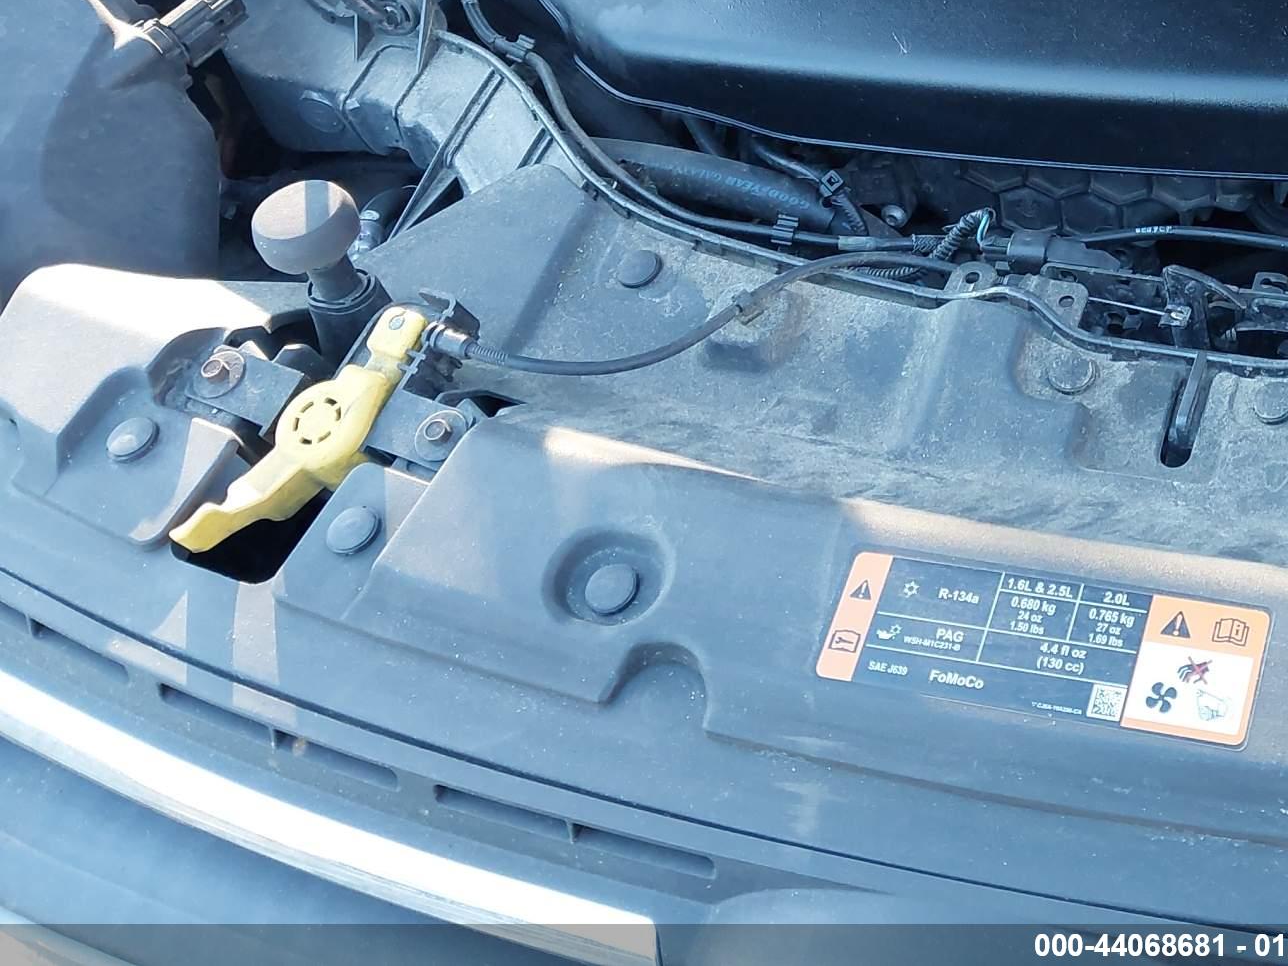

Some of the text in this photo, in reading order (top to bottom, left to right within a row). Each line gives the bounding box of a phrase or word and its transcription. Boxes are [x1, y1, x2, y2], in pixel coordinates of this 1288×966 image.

[938, 587, 980, 605] R-134a
[1007, 578, 1073, 598] 1.6L & 2.5L
[1010, 597, 1056, 616] 0.680 kg
[1103, 591, 1130, 606] 2.0L
[1017, 610, 1043, 623] 24 oz
[1089, 609, 1135, 628] 0.765 kg
[935, 627, 964, 643] PAG
[1010, 621, 1044, 635] 1.50 lbs
[1096, 623, 1122, 635] 27 oz
[1088, 633, 1123, 647] 1.69 lbs
[1040, 642, 1087, 660] 4.4 fl oz
[867, 660, 887, 674] SAE
[1036, 656, 1084, 675] (130 cc)
[929, 669, 984, 690] FoMoCo
